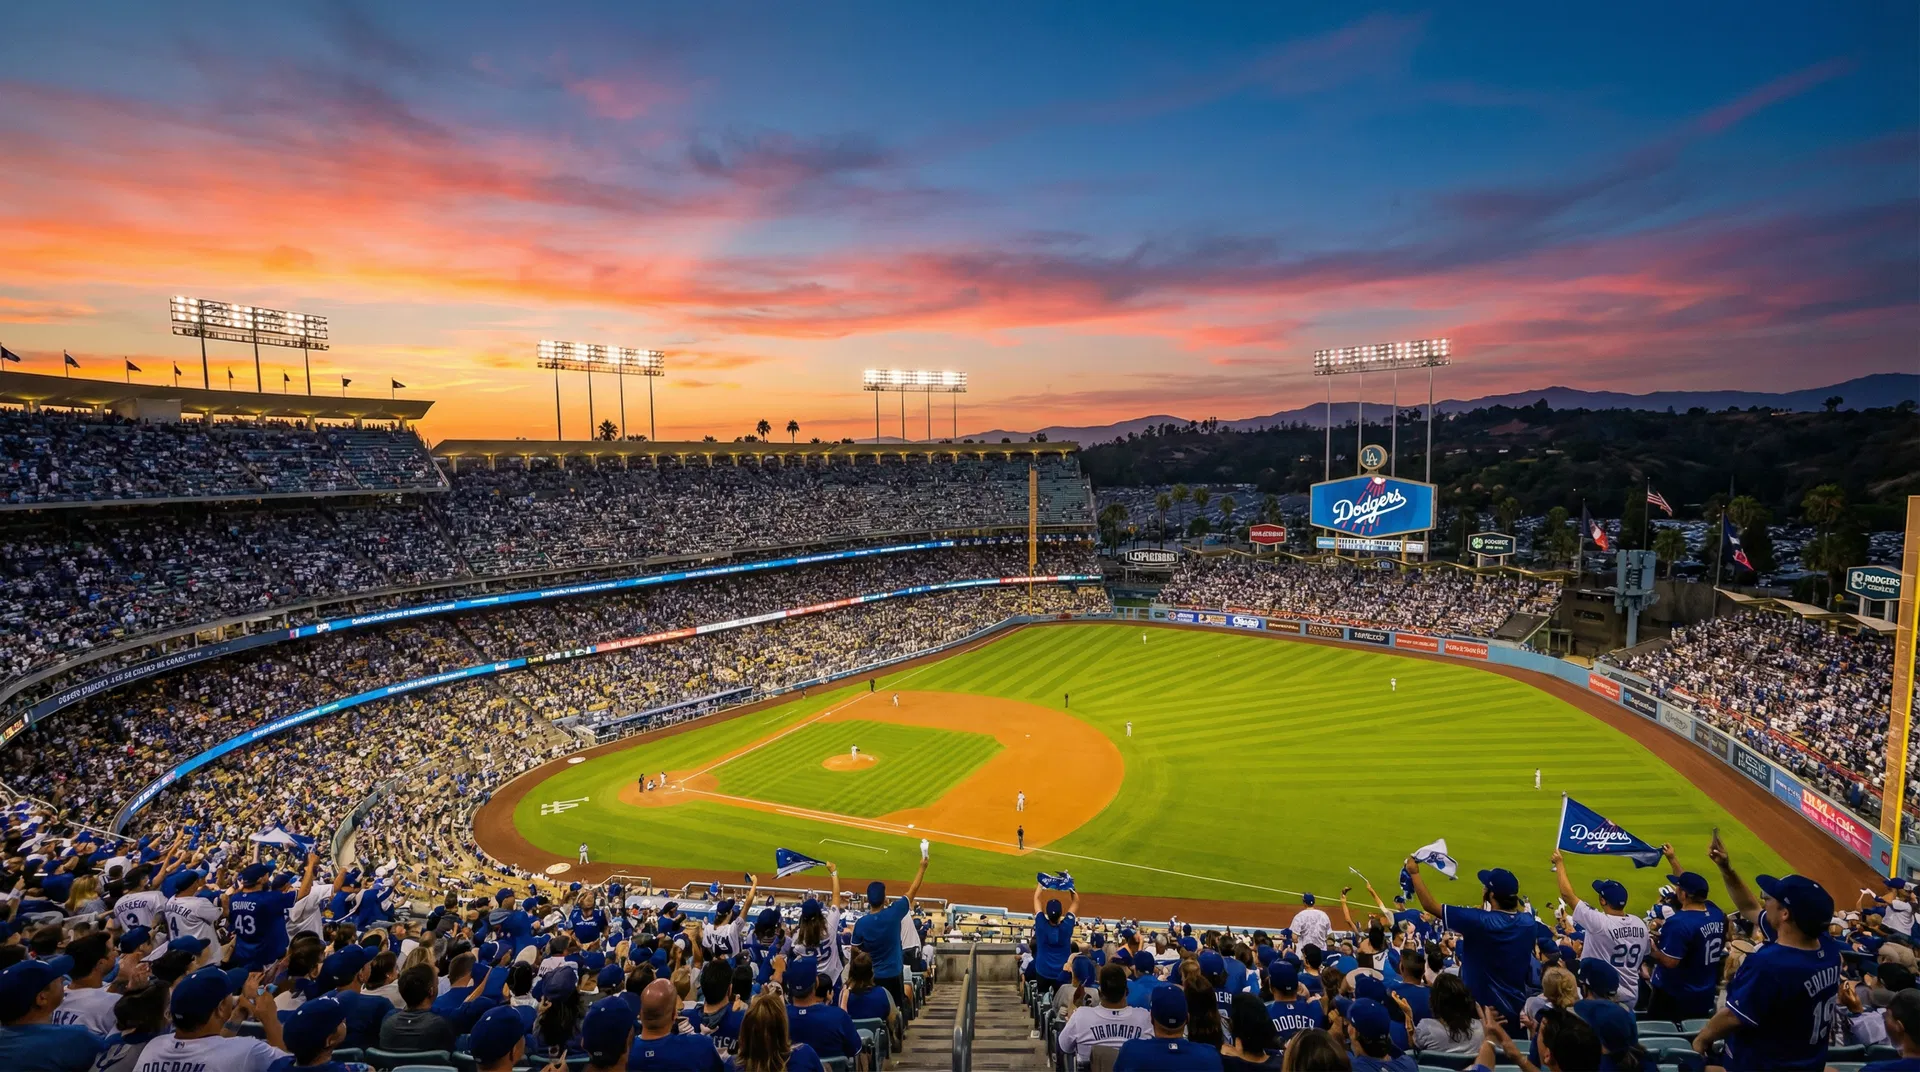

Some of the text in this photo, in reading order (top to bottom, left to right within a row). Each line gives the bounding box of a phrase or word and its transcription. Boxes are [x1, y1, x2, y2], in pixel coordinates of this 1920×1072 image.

[1332, 488, 1407, 525] Dodgers
[1569, 823, 1632, 850] Dodgers
[170, 916, 180, 937] 4
[234, 914, 257, 935] 43
[1610, 943, 1642, 968] 29
[1704, 937, 1722, 966] 12
